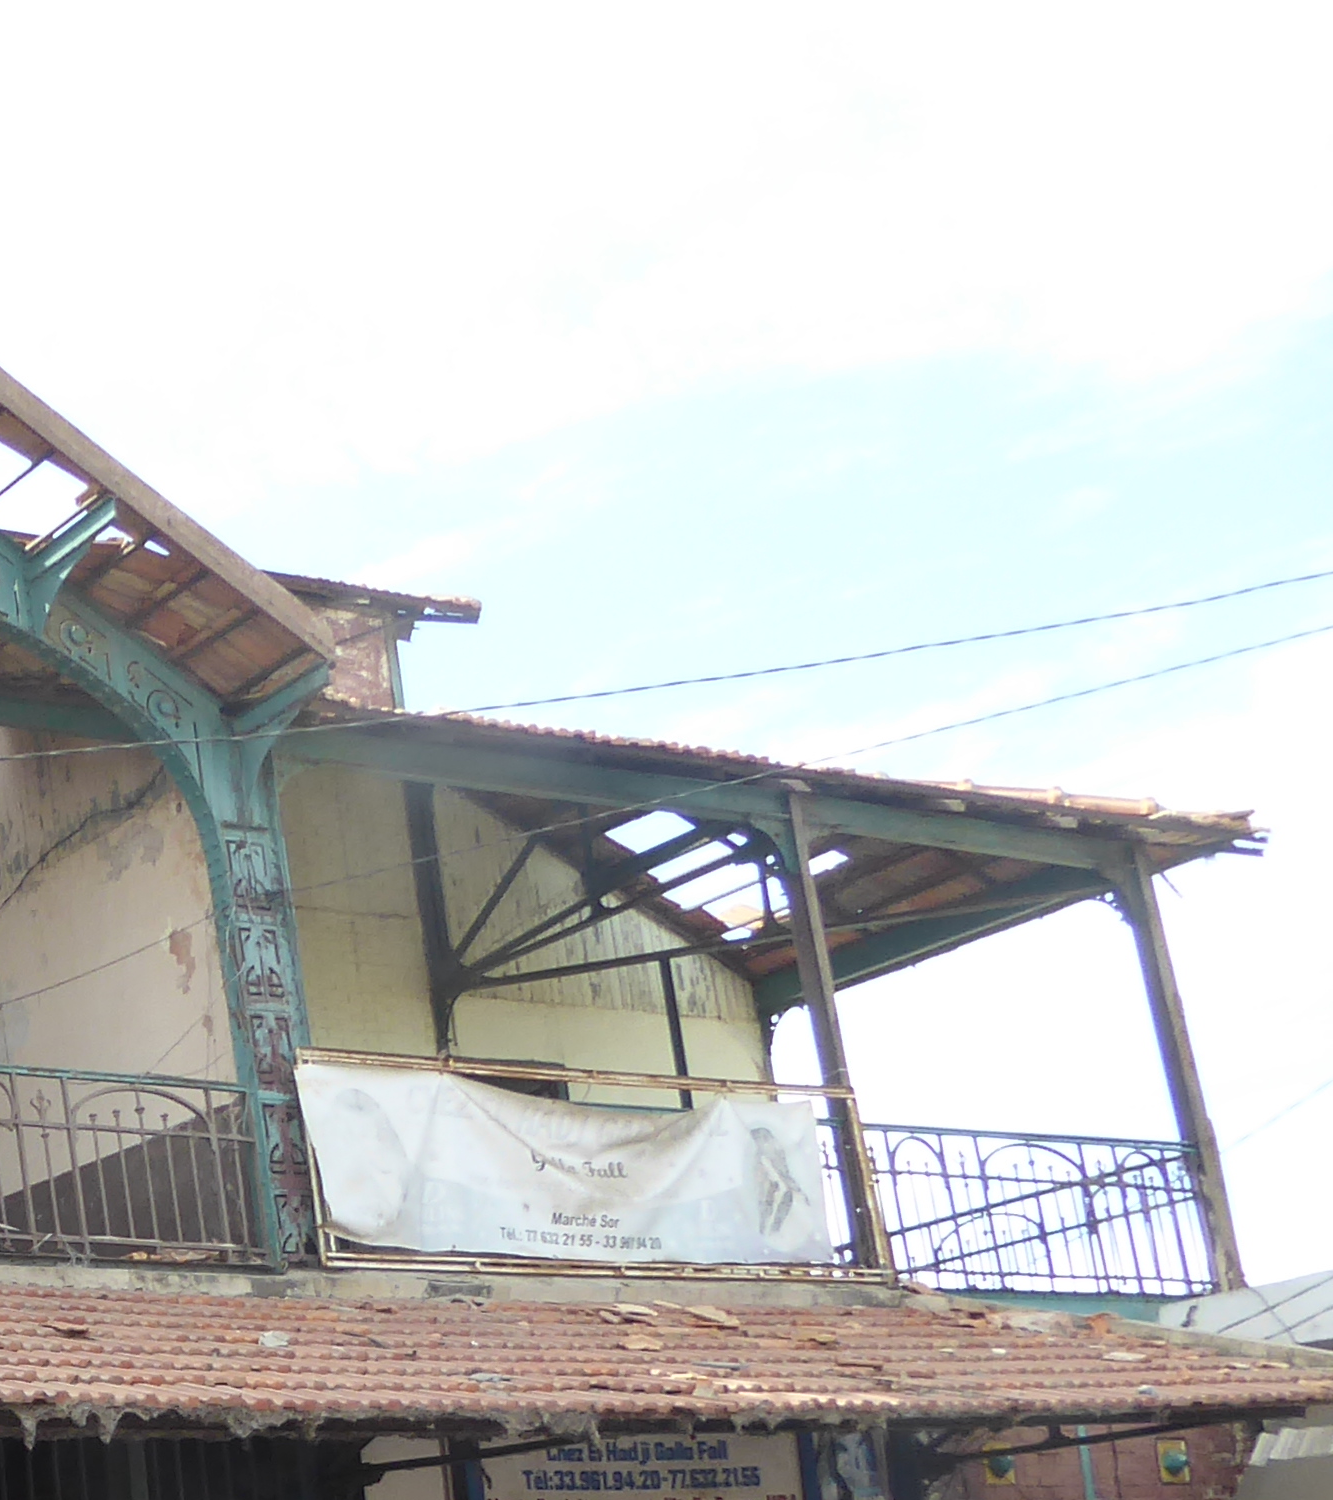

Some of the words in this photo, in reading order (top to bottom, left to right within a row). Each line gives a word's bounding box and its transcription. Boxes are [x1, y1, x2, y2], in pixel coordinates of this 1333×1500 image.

[582, 1161, 628, 1179] Fall
[550, 1212, 597, 1228] Marché
[599, 1214, 620, 1229] Sor
[562, 1233, 575, 1246] 21
[578, 1234, 593, 1247] 55
[603, 1235, 616, 1249] 33
[697, 1439, 728, 1460] Fall
